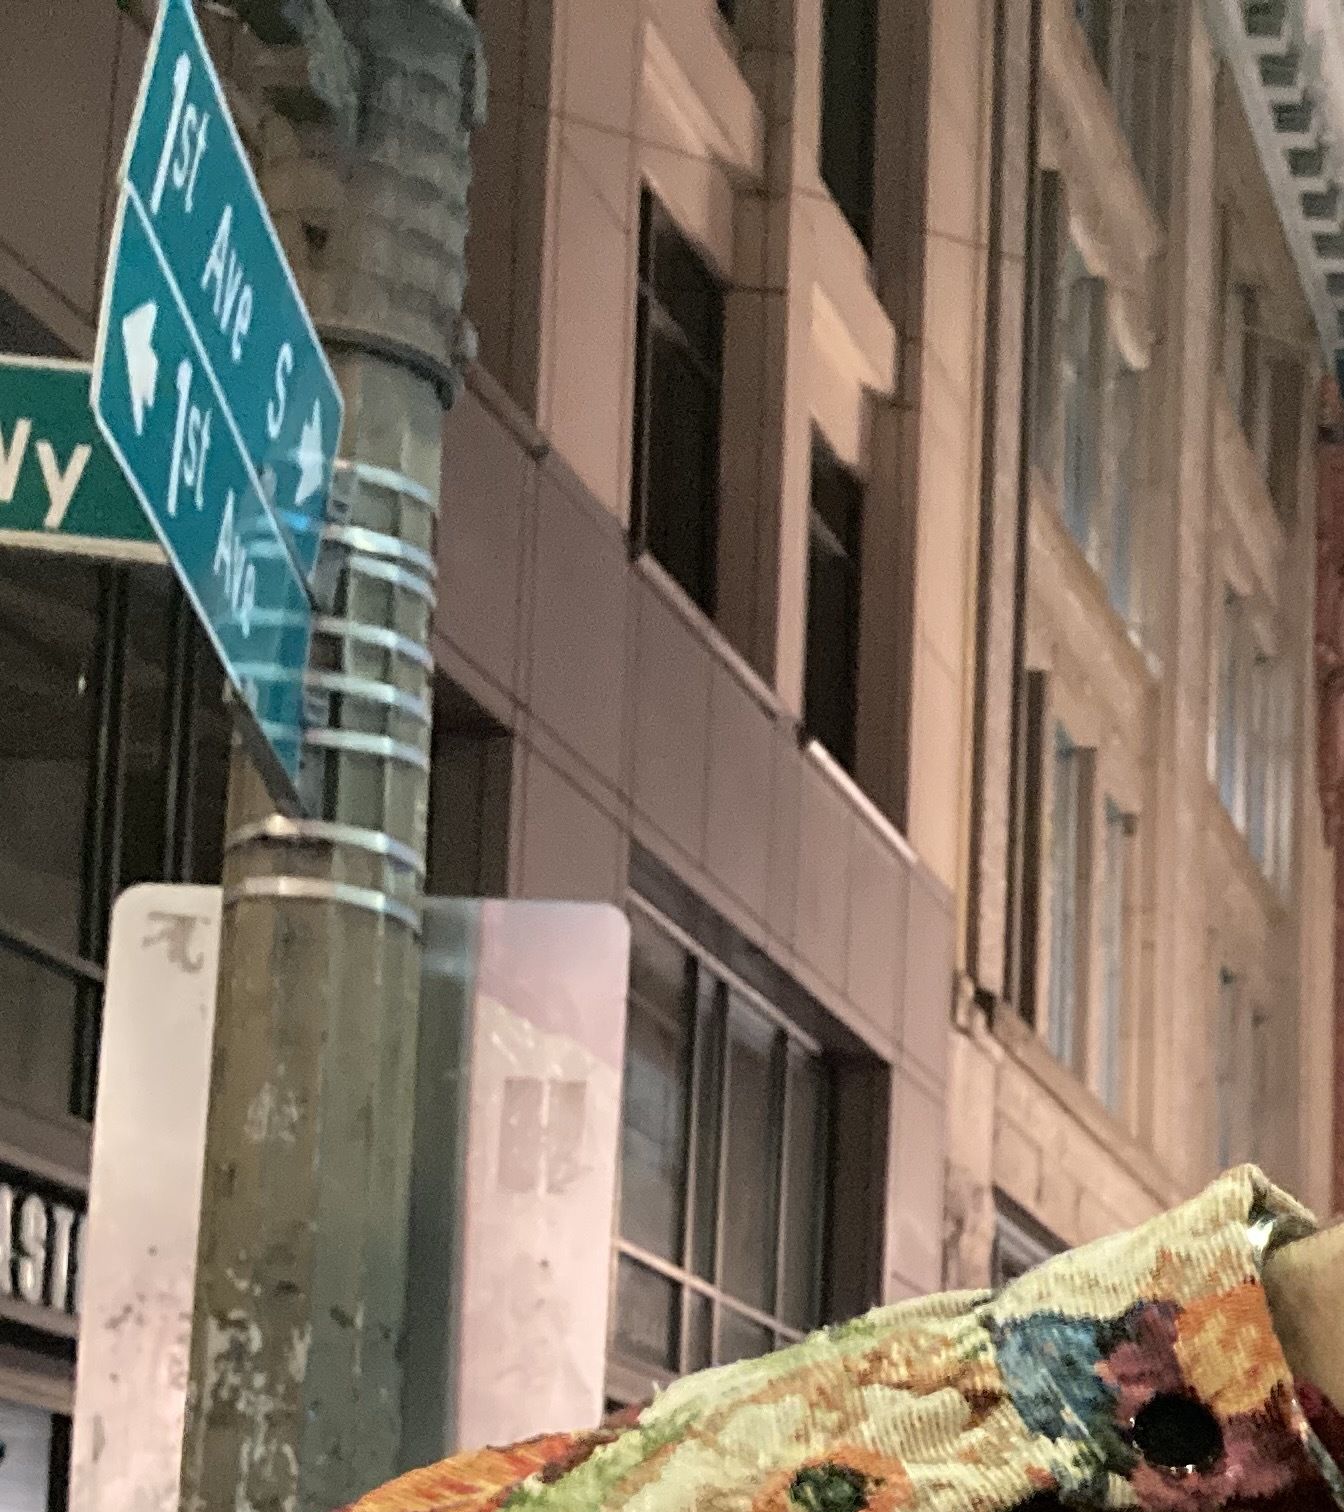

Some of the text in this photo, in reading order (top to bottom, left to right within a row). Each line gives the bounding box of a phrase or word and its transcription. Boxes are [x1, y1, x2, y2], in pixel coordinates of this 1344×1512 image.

[150, 51, 294, 439] 1st Ave S
[167, 359, 256, 638] 1st Ave
